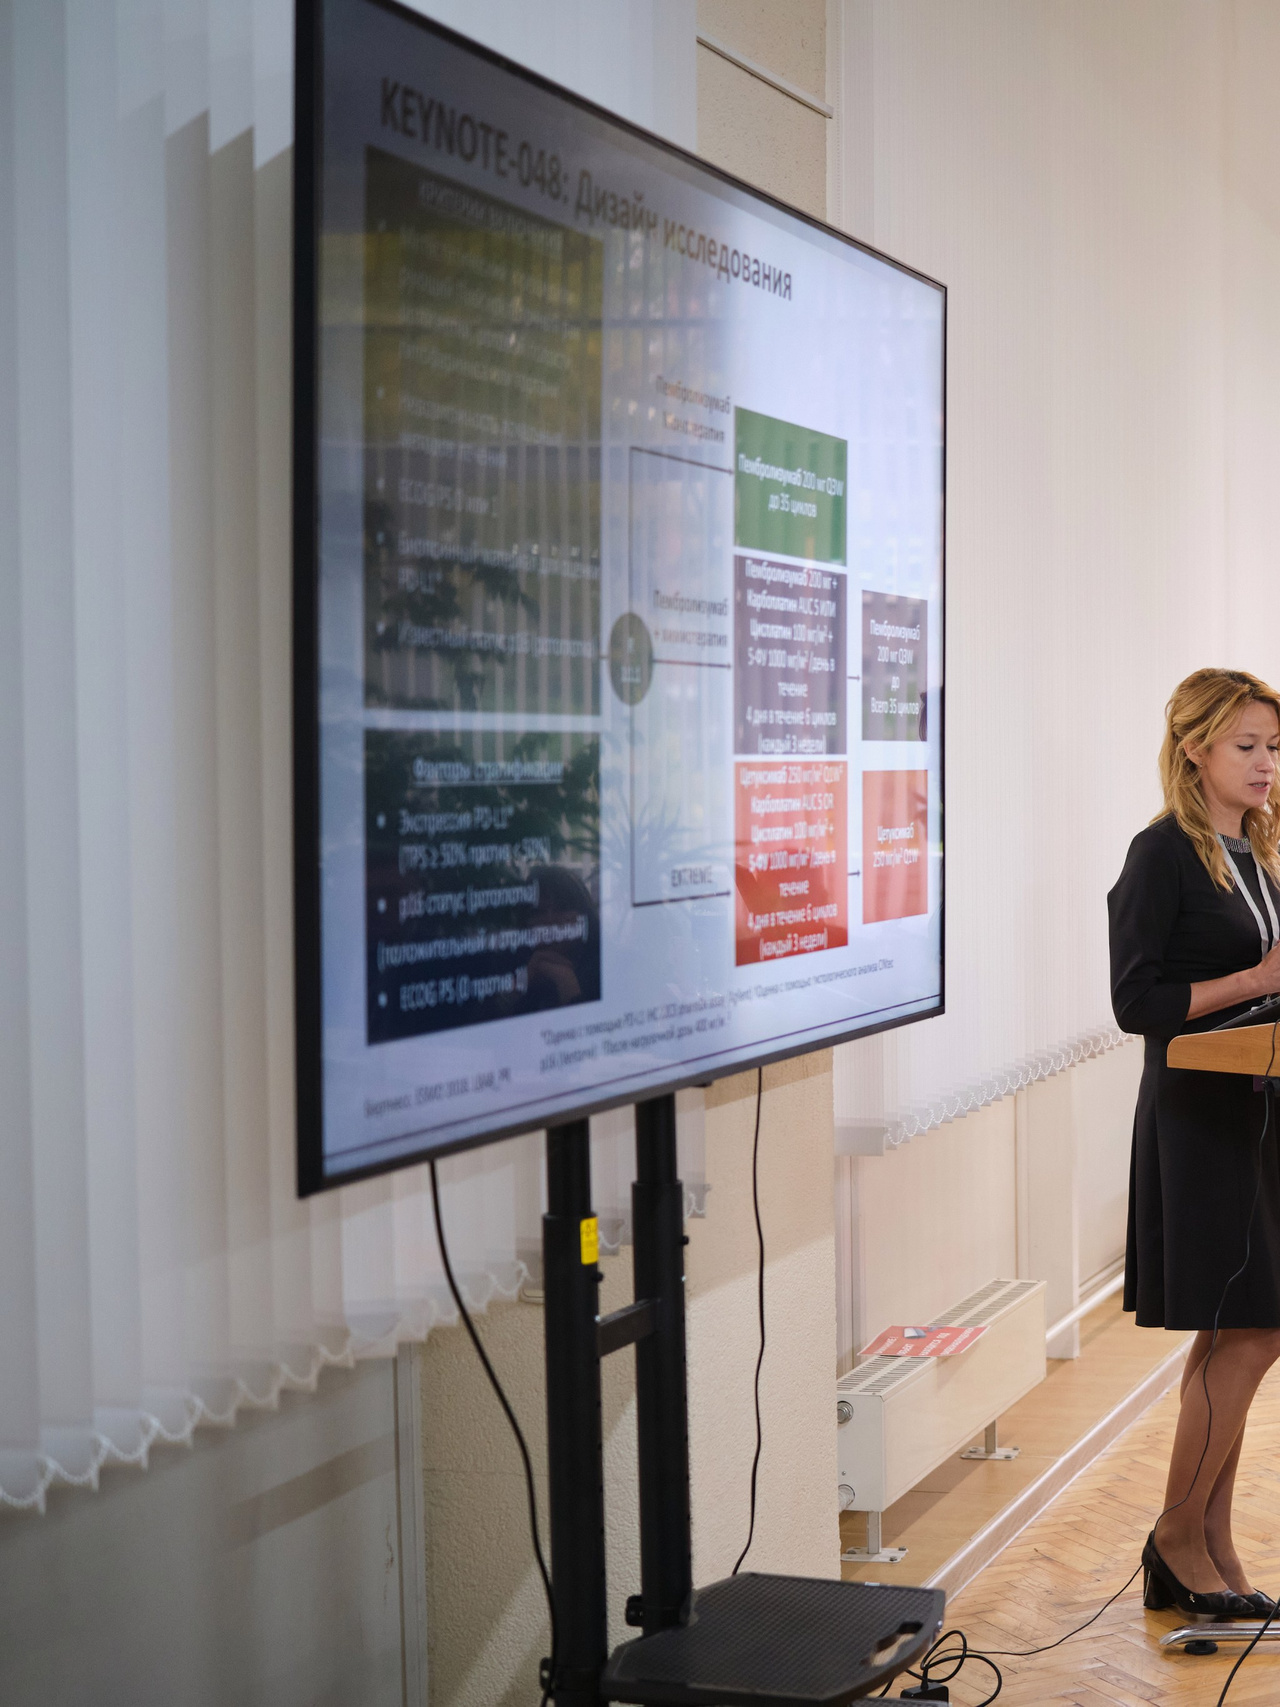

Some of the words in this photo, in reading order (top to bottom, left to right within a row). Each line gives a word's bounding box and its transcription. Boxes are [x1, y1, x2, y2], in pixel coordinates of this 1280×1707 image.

[382, 77, 568, 203] KEYNOTE-048:
[576, 170, 658, 238] Дизайн
[665, 218, 792, 300] исследования
[769, 494, 778, 512] до
[780, 493, 789, 512] 35
[791, 501, 817, 517] циклов
[778, 682, 808, 697] течение
[889, 698, 897, 714] 35
[779, 880, 809, 897] течение
